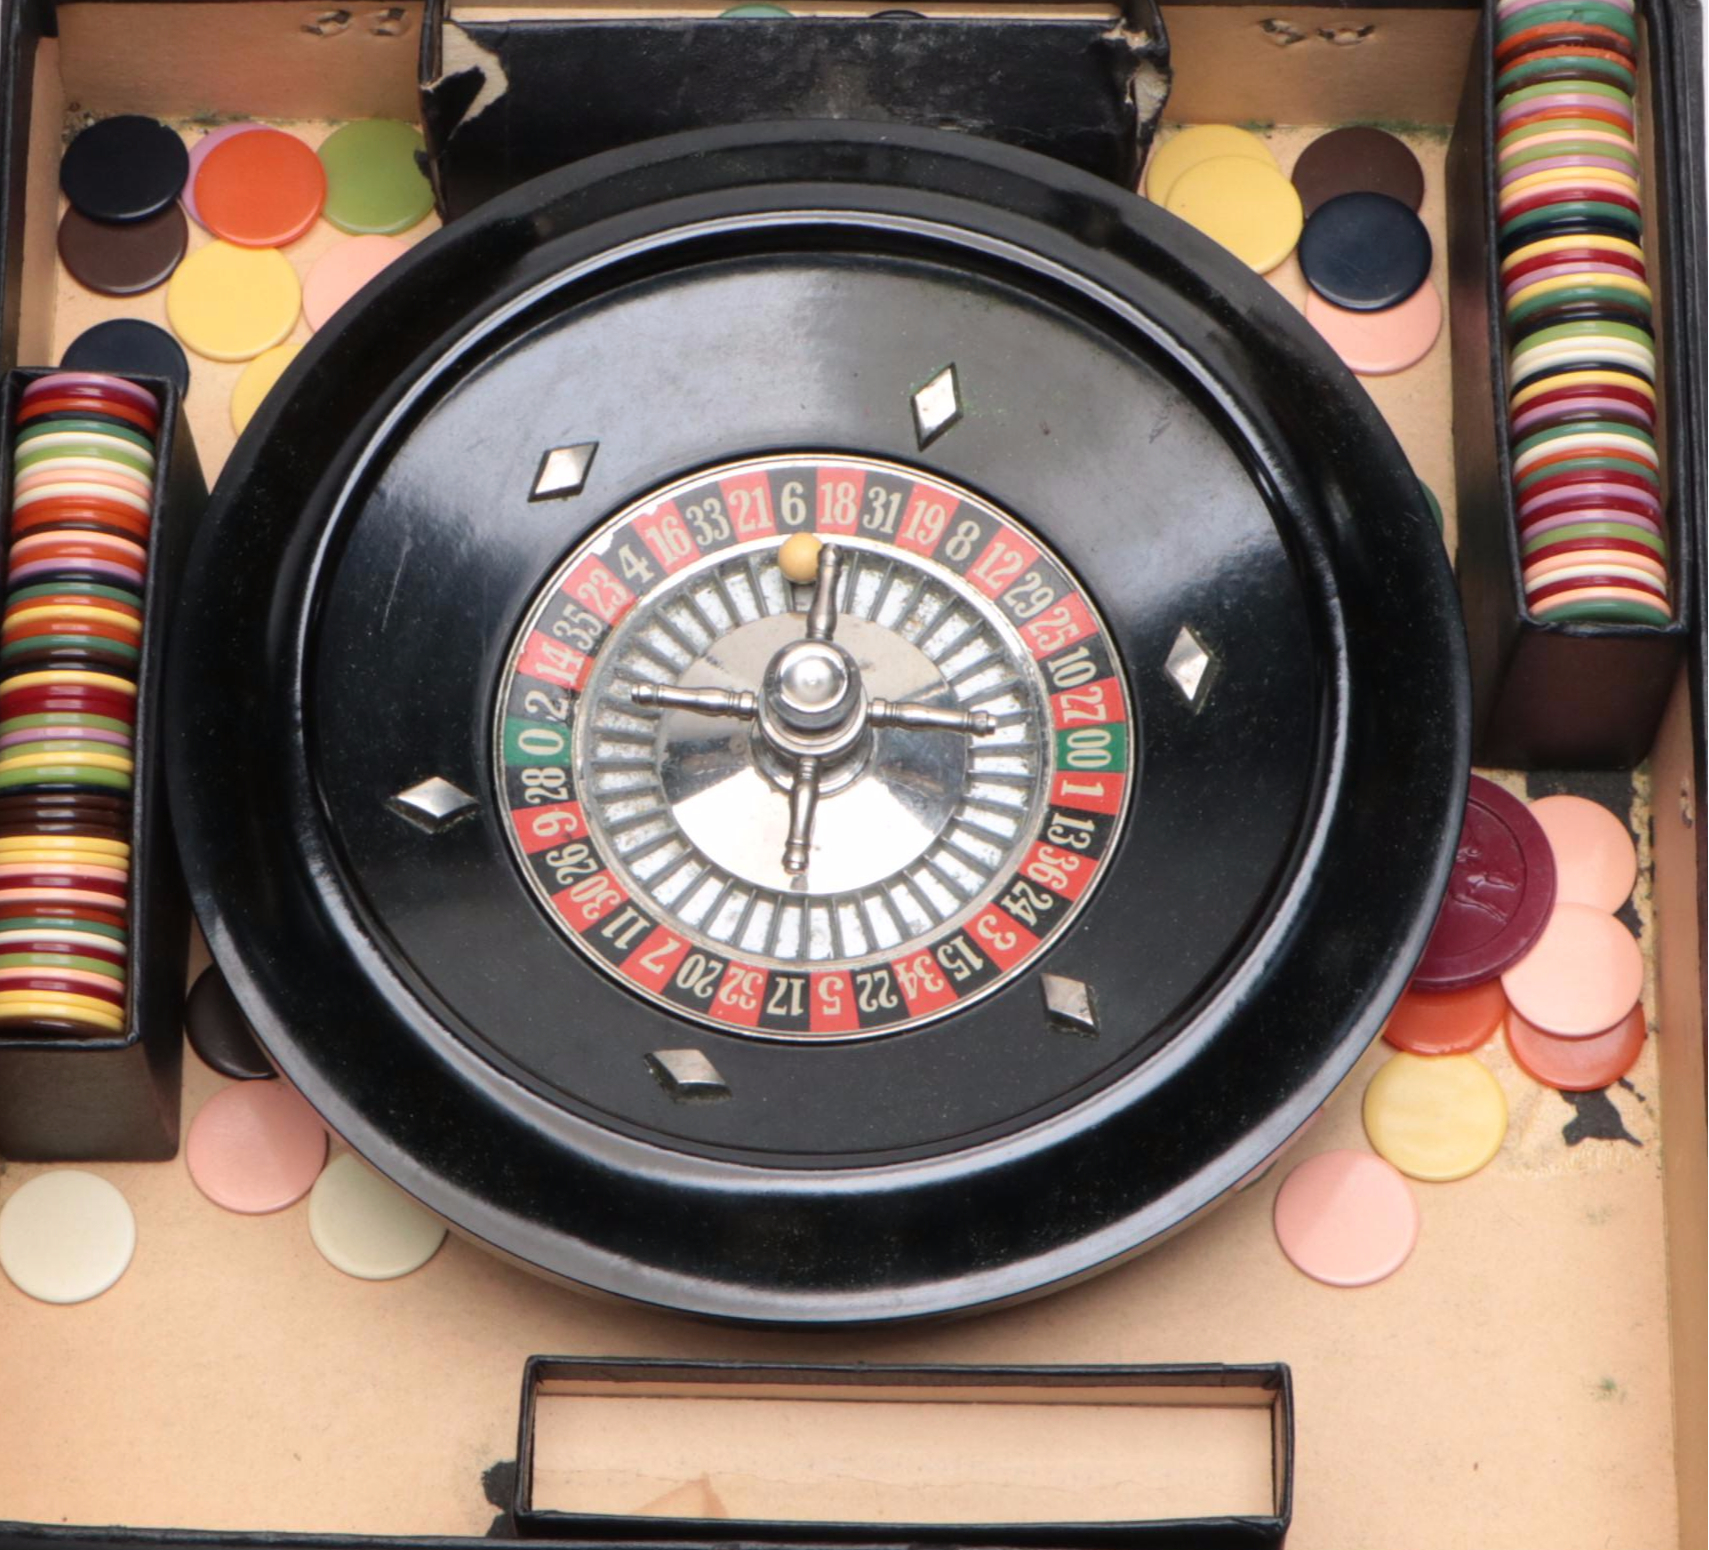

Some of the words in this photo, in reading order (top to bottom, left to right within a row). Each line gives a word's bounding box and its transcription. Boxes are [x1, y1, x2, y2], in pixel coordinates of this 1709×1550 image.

[686, 498, 730, 545] 33
[728, 486, 773, 533] 21
[781, 482, 806, 525] 6
[821, 482, 857, 525] 18
[863, 487, 902, 533] 31
[902, 500, 945, 545] 19
[646, 515, 692, 566] 16
[945, 520, 980, 560] 8
[617, 544, 654, 583] 4
[972, 542, 1023, 589] 12
[578, 569, 627, 619] 23
[1003, 572, 1054, 618] 29
[553, 604, 603, 650] 35
[1027, 607, 1081, 650] 25
[536, 642, 584, 685] 14
[1047, 646, 1096, 688] 10
[524, 691, 569, 722] 2
[1060, 686, 1106, 722] 27
[518, 729, 564, 755] 0
[1066, 729, 1111, 768] 00
[521, 767, 568, 804] 28
[1060, 779, 1104, 797] 1
[532, 811, 577, 837] 9
[1047, 812, 1095, 849] 13
[545, 843, 598, 884] 26
[1027, 846, 1080, 890] 36
[570, 875, 621, 919] 30
[1002, 881, 1053, 927] 24
[601, 907, 650, 949] 11
[977, 914, 1016, 950] 3
[639, 937, 681, 974] 7
[676, 953, 724, 998] 20
[936, 935, 983, 981] 15
[718, 967, 763, 1010] 32
[766, 977, 805, 1016] 17
[818, 976, 844, 1015] 5
[856, 971, 898, 1012] 22
[897, 956, 944, 1000] 34
